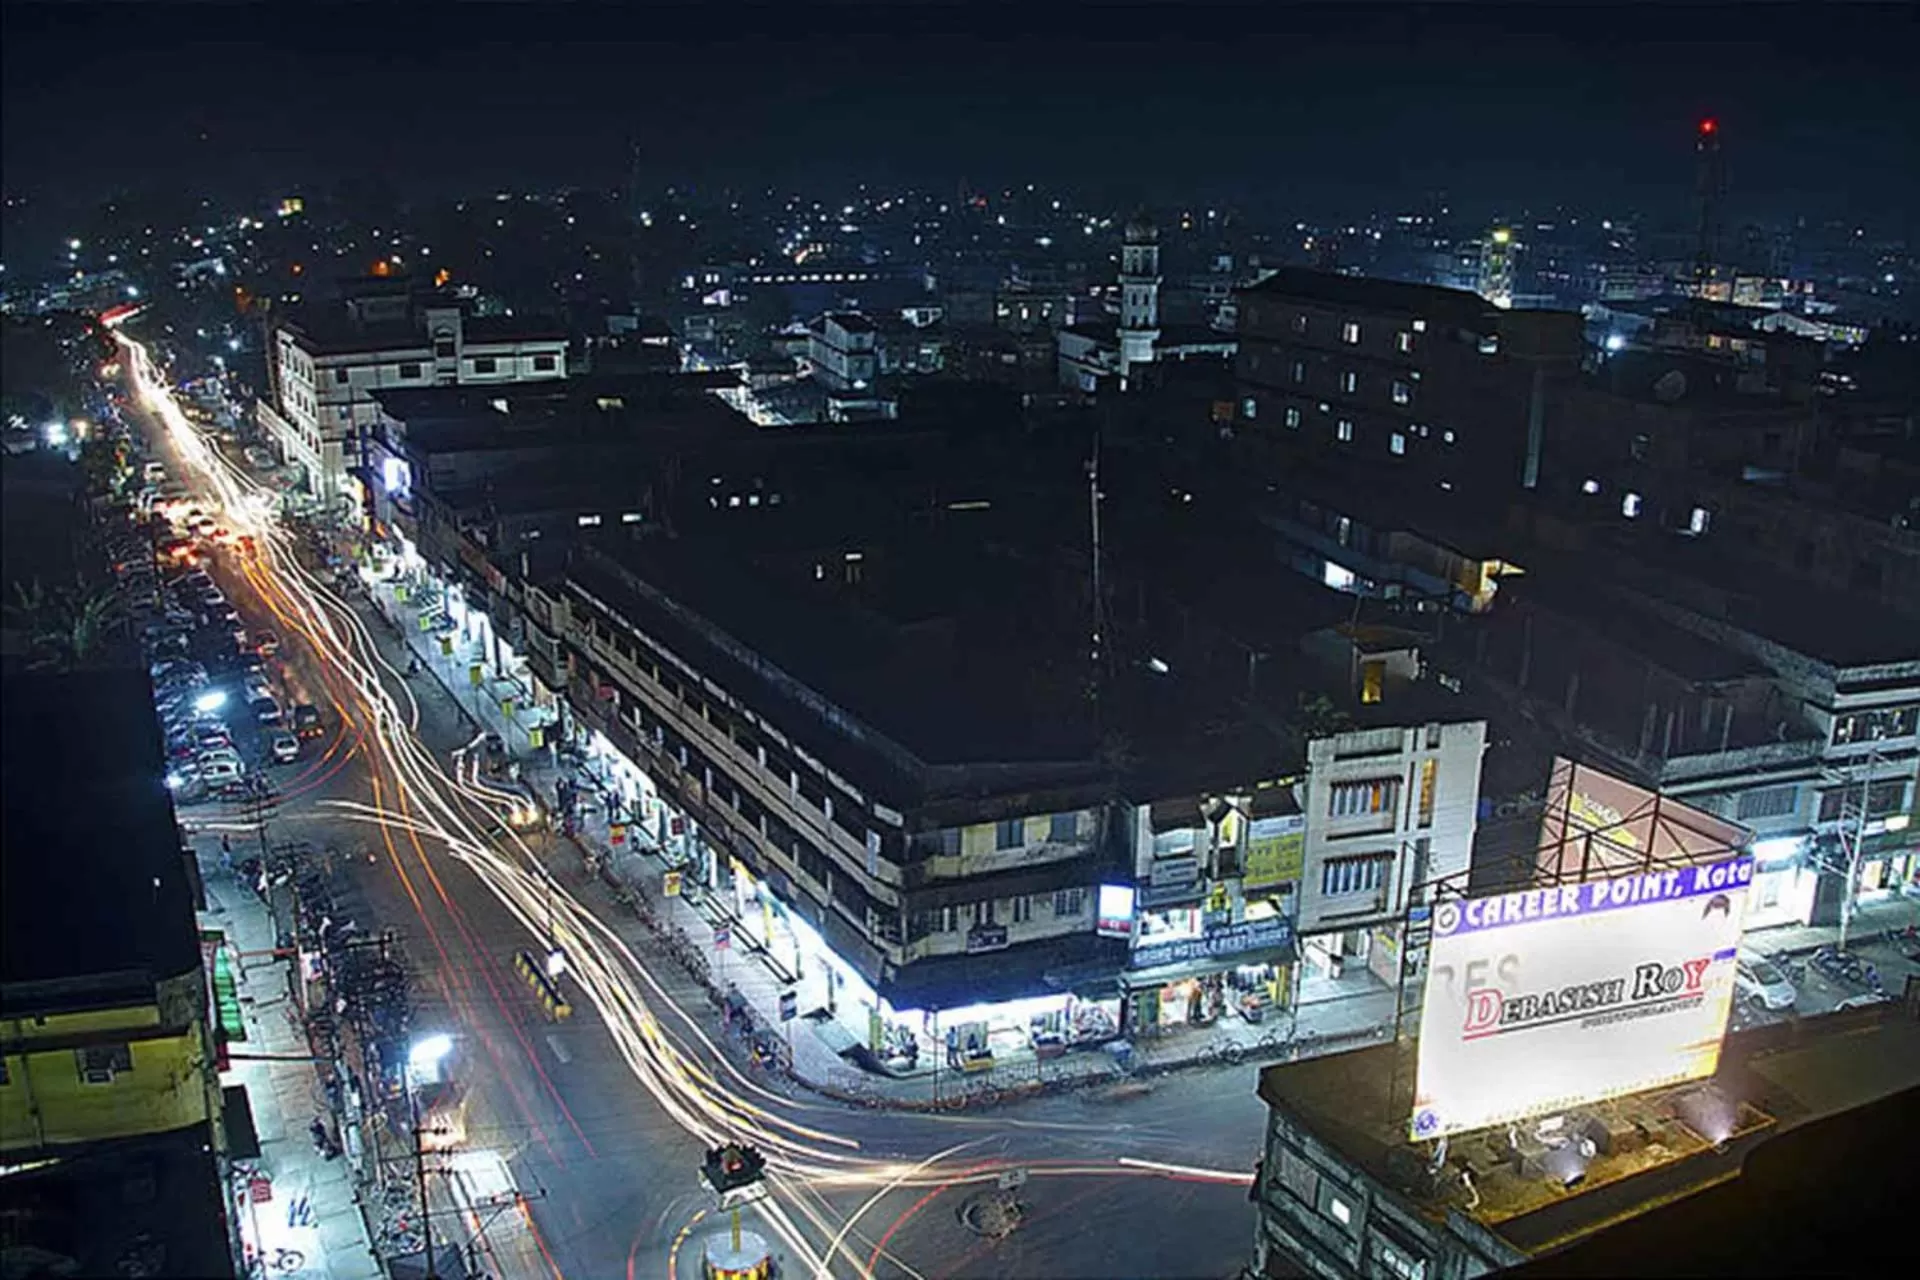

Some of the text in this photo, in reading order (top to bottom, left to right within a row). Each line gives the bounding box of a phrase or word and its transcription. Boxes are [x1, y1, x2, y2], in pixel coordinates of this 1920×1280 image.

[1466, 861, 1751, 928] CAREER POINT, Kota
